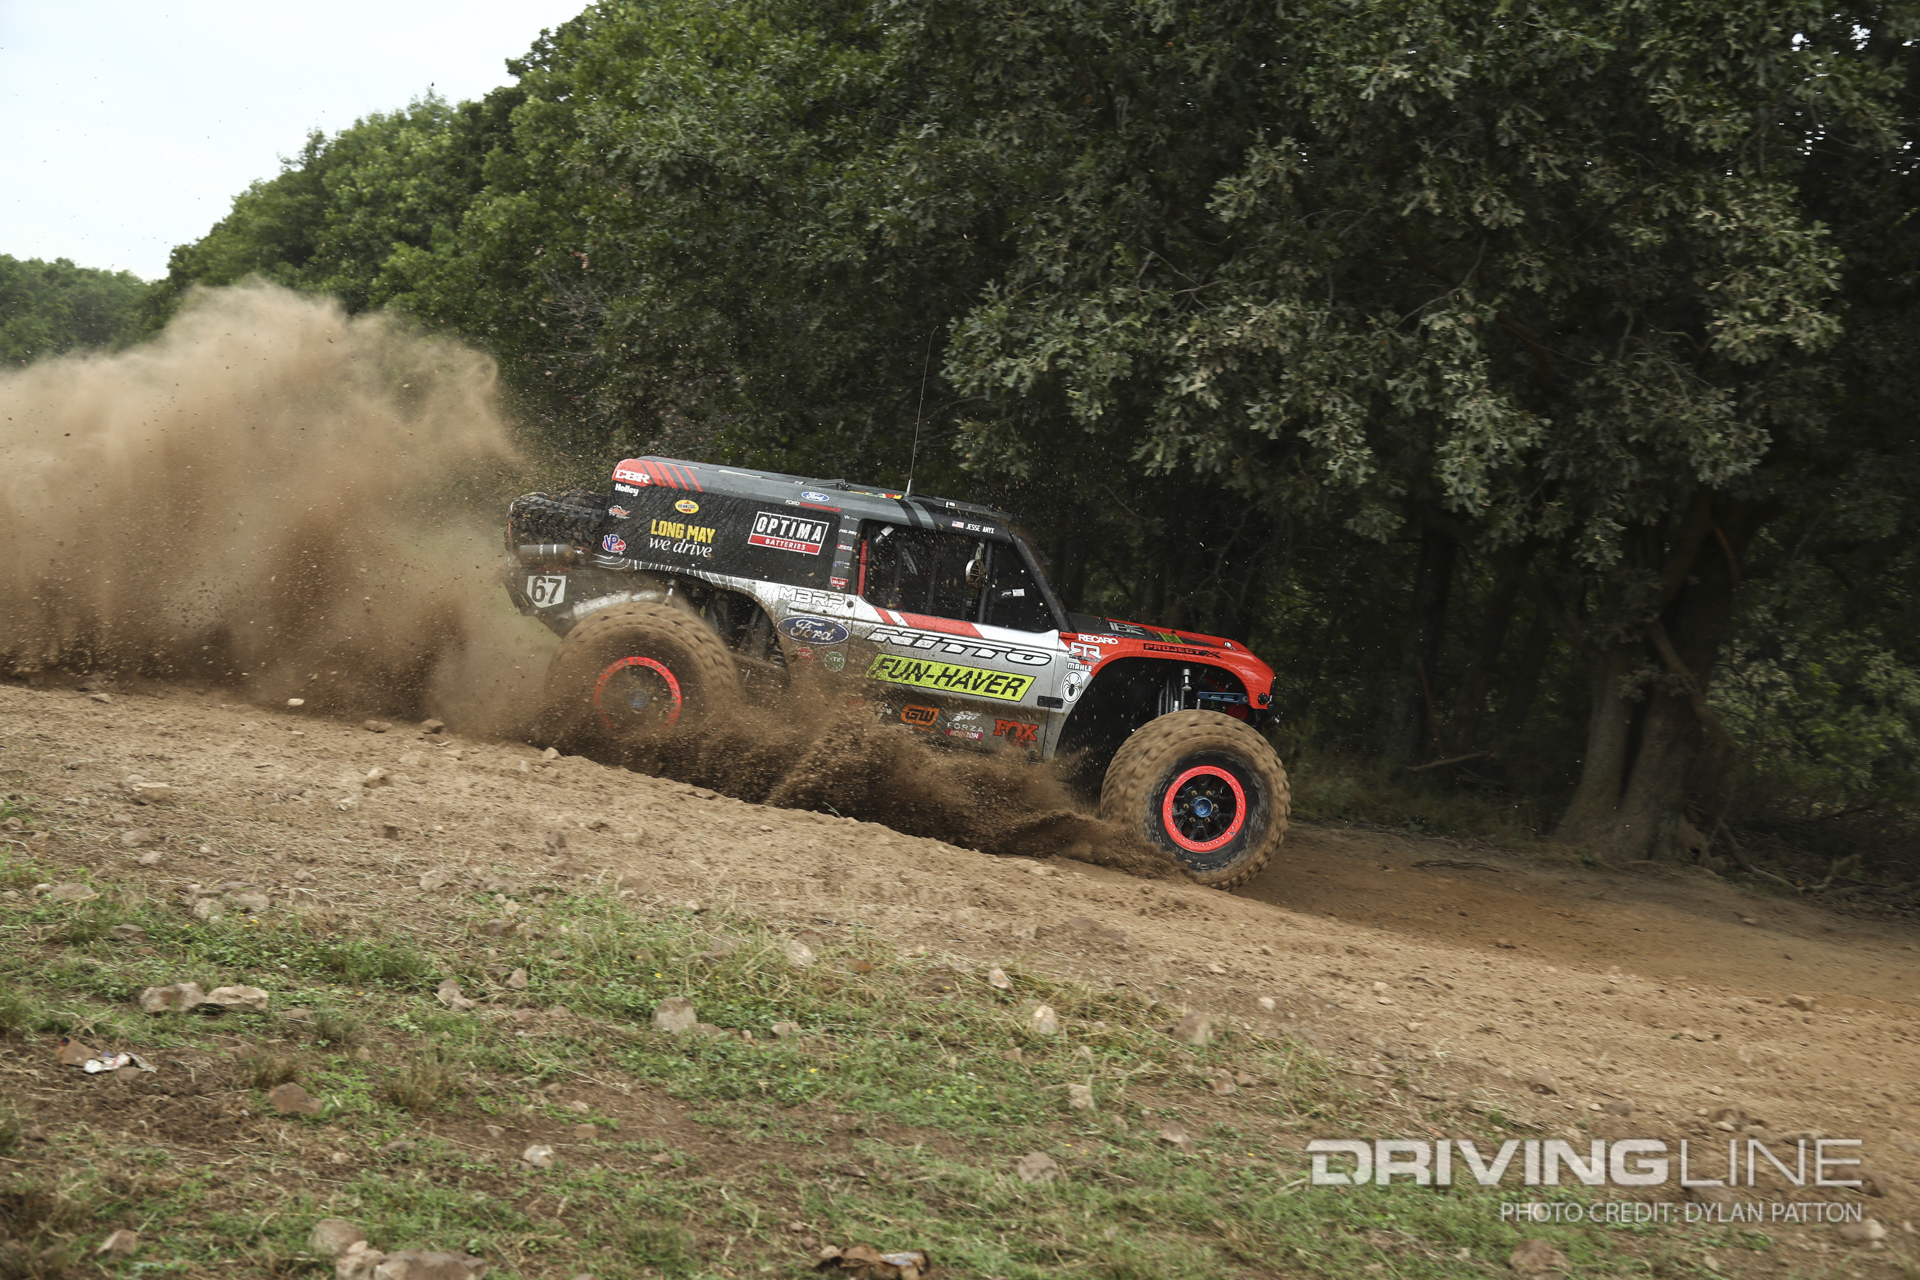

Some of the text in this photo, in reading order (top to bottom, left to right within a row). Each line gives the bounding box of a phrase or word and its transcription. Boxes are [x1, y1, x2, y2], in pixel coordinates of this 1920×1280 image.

[614, 483, 639, 497] Holley
[650, 519, 716, 544] LONG MAY
[756, 516, 823, 542] OPTIMA
[604, 535, 620, 552] VP
[649, 538, 713, 558] we drive
[765, 538, 807, 551] BATTERIES
[531, 576, 562, 604] 67
[778, 586, 846, 608] MBRP
[790, 618, 836, 641] Ford
[866, 627, 1052, 666] NITTO
[1078, 633, 1119, 645] RECARO
[1144, 643, 1201, 655] PROJECT
[1067, 662, 1093, 672] MAHLE
[872, 656, 1027, 698] FUN-HAVER
[905, 708, 936, 723] GW
[947, 721, 985, 733] FORZA
[949, 730, 980, 740] HORIZON
[993, 718, 1040, 744] FOX
